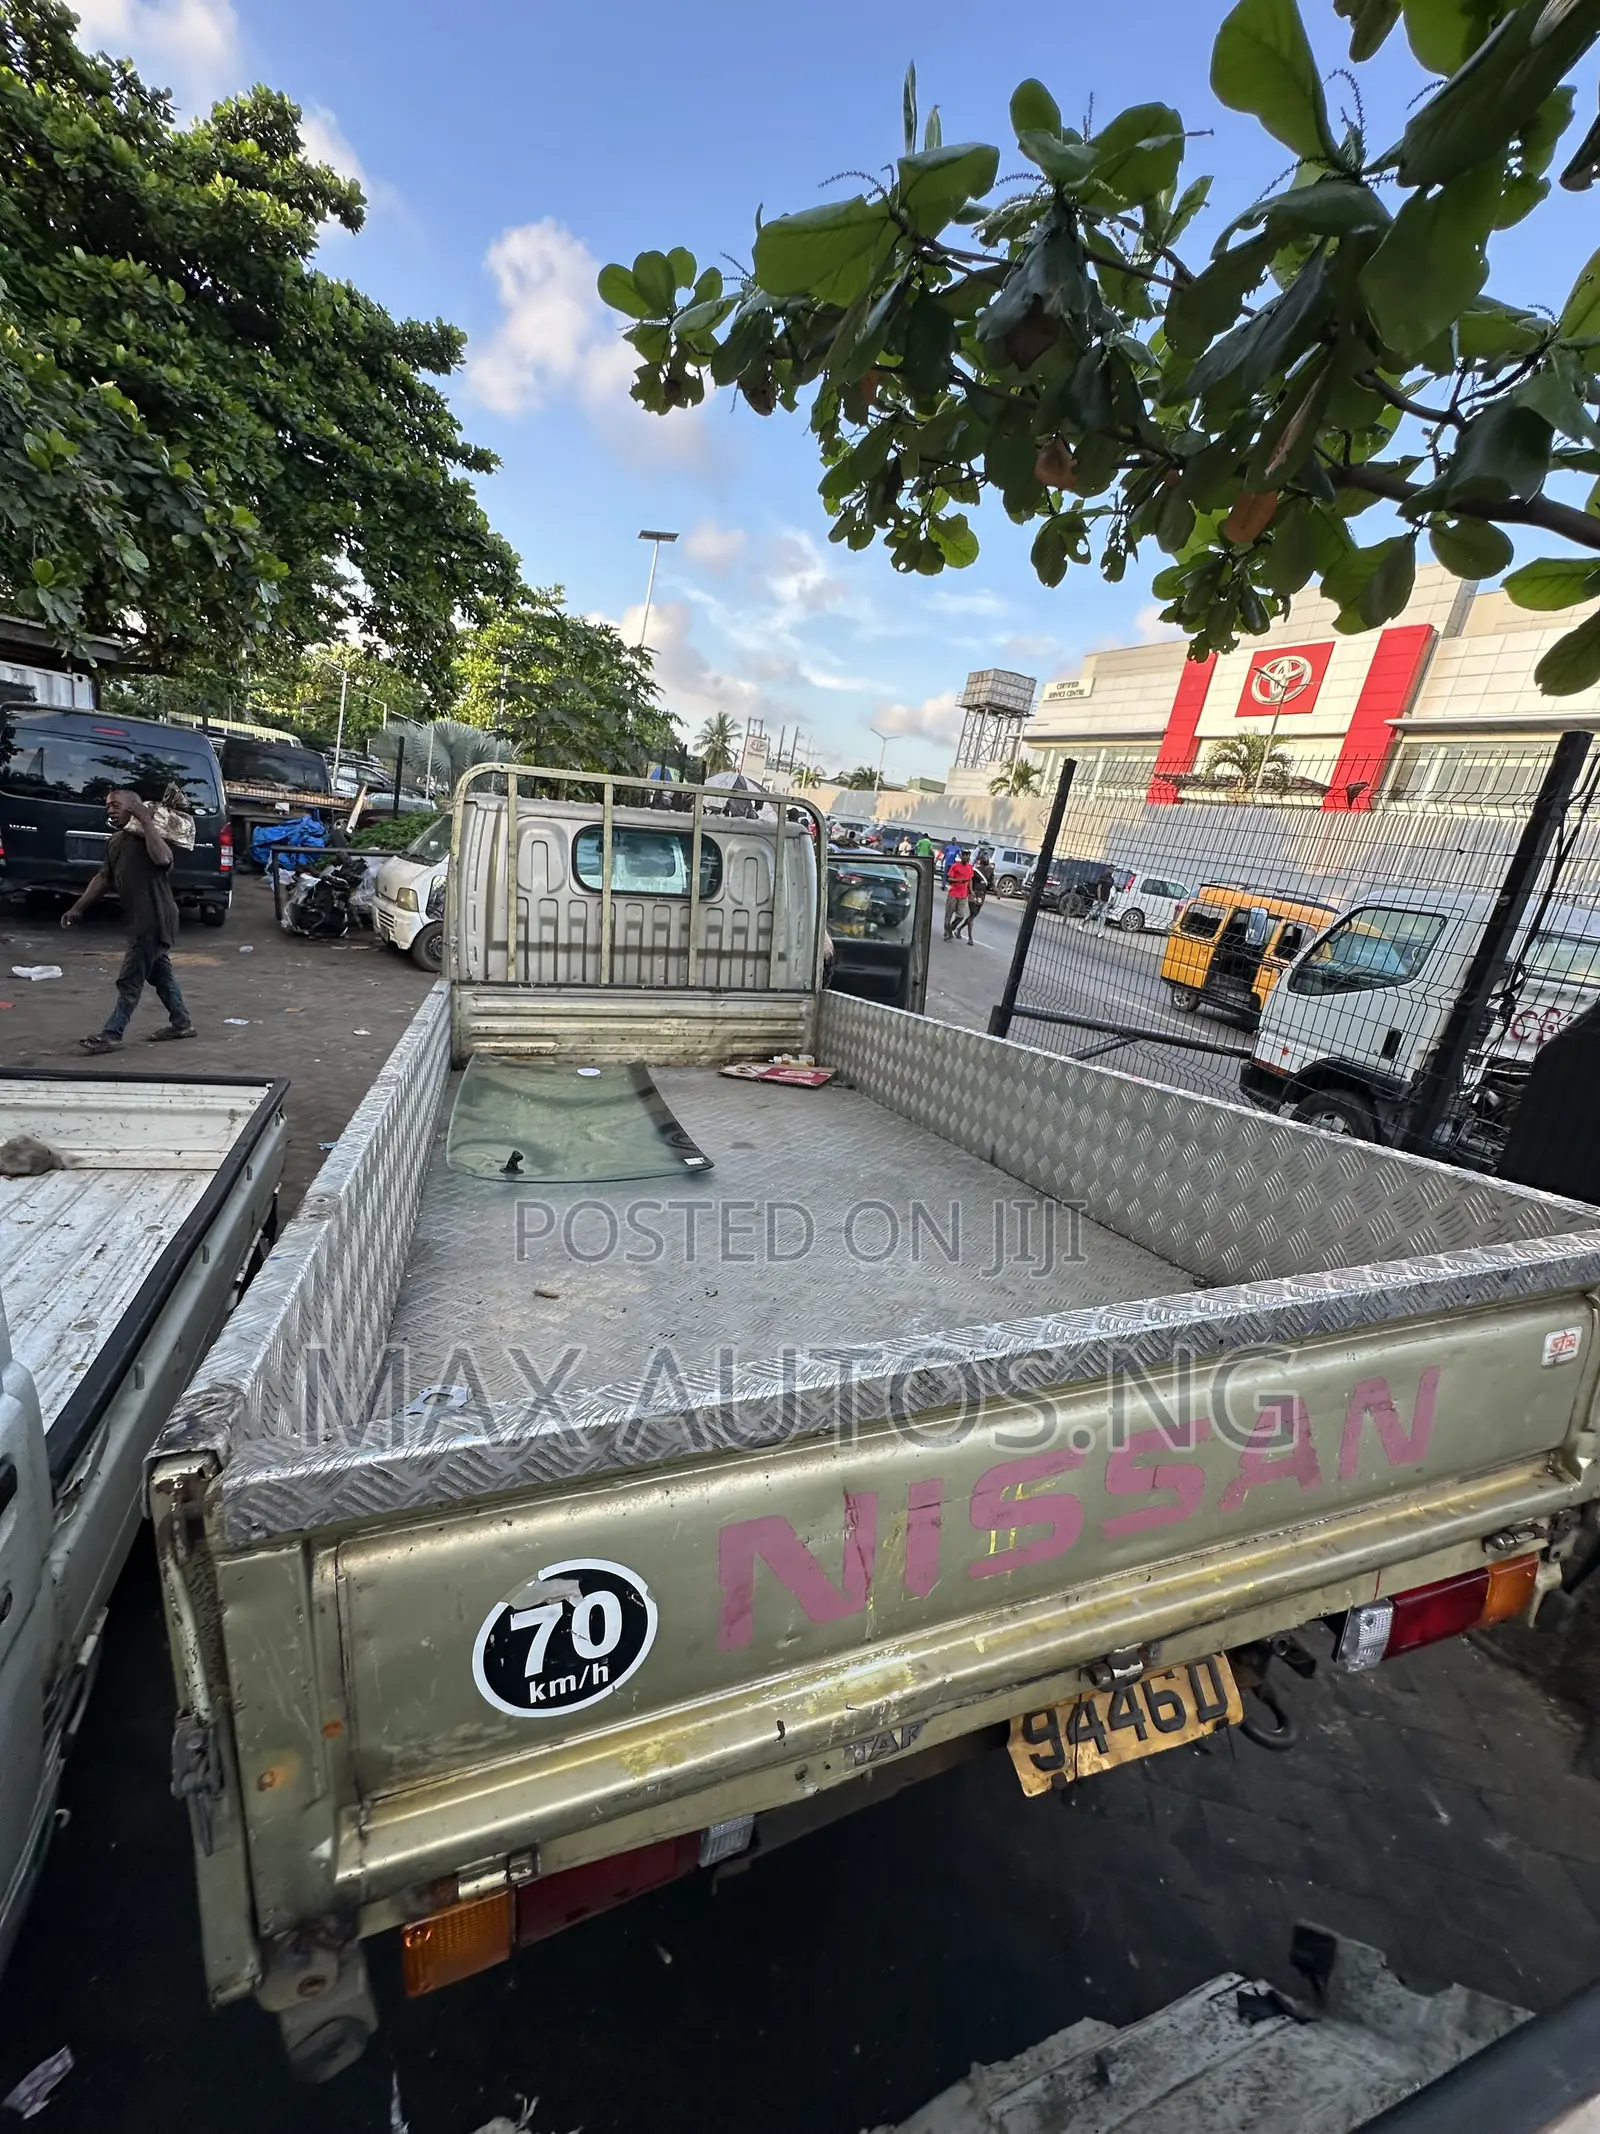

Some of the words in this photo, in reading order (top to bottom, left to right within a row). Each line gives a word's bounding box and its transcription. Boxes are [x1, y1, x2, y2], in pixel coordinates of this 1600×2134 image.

[1048, 690, 1066, 699] SERVICE
[1066, 689, 1085, 697] CENTRE
[1056, 681, 1080, 690] CERTIFIED
[719, 1365, 1442, 1652] NISSAN
[510, 1590, 623, 1678] 70
[529, 1663, 609, 1704] km/h
